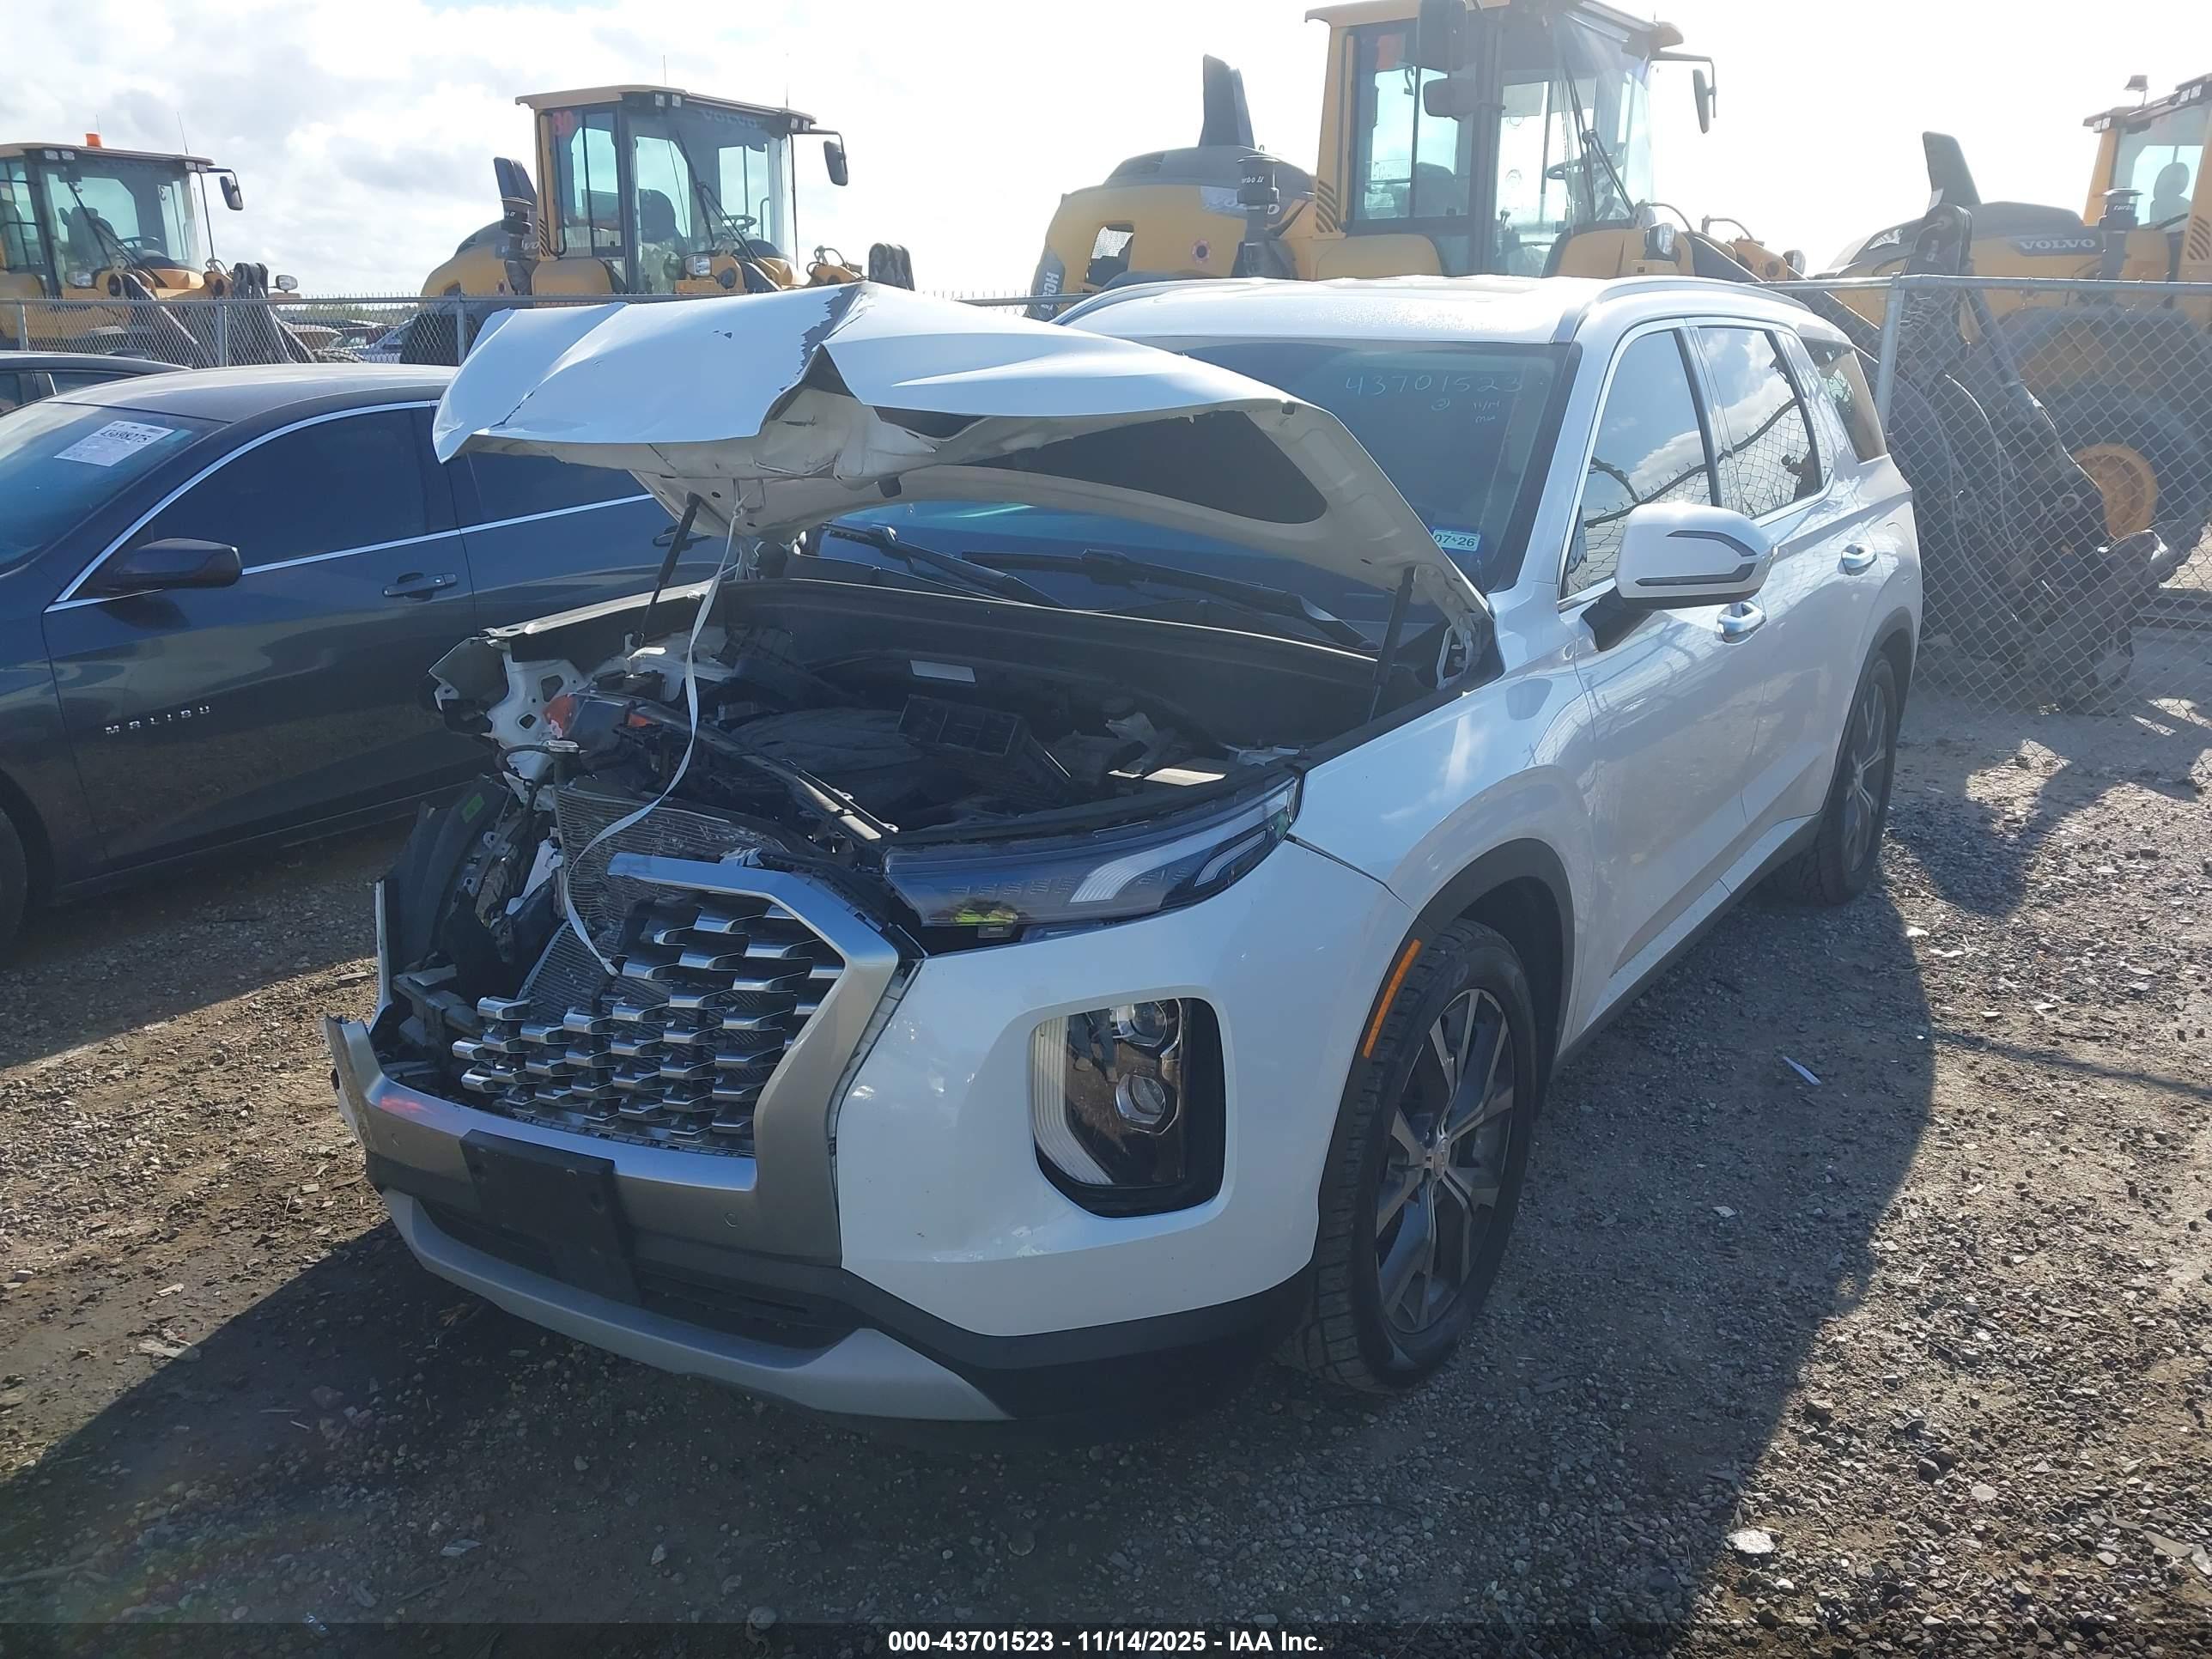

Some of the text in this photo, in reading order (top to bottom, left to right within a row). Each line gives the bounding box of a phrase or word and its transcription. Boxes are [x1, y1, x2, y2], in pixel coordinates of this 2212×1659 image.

[2020, 239, 2095, 249] VOLVO
[1346, 374, 1523, 395] 43701523
[1457, 537, 1475, 547] 26
[105, 705, 211, 734] MALIBU
